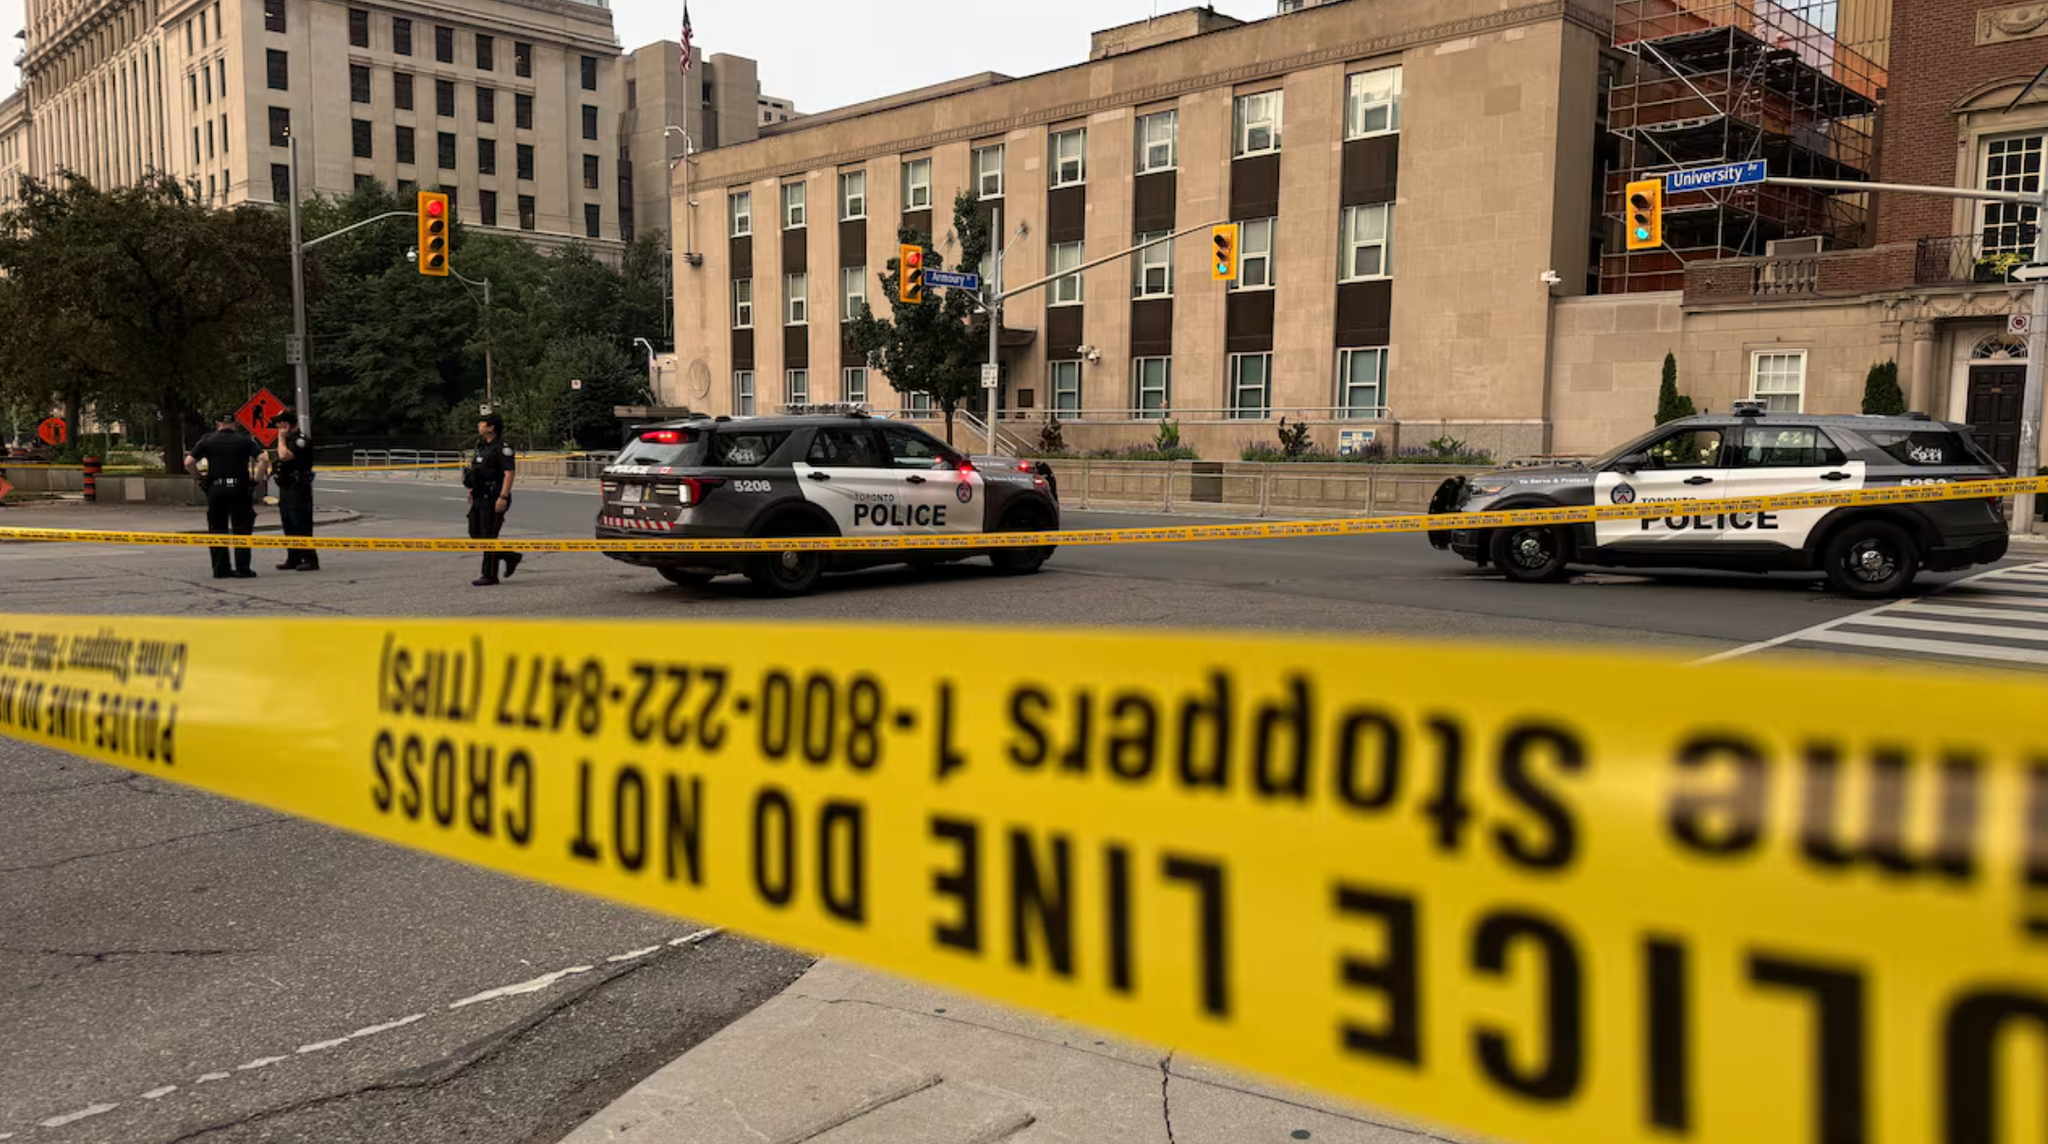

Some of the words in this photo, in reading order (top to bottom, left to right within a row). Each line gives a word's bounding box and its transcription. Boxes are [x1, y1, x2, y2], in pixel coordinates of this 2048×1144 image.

[1673, 164, 1743, 187] University
[734, 480, 772, 492] 5208
[854, 493, 895, 501] TORONTO
[854, 503, 947, 526] POLICE
[1641, 510, 1779, 531] POLICE
[379, 632, 484, 728] (TIPS)
[495, 653, 967, 784] 1-800-222-8477
[95, 690, 181, 767] POLICE
[1006, 667, 1590, 879] Stoppers
[371, 728, 536, 849] CROSS
[567, 759, 705, 889] NOT
[750, 785, 868, 930] DO
[927, 812, 1233, 1023] LINE
